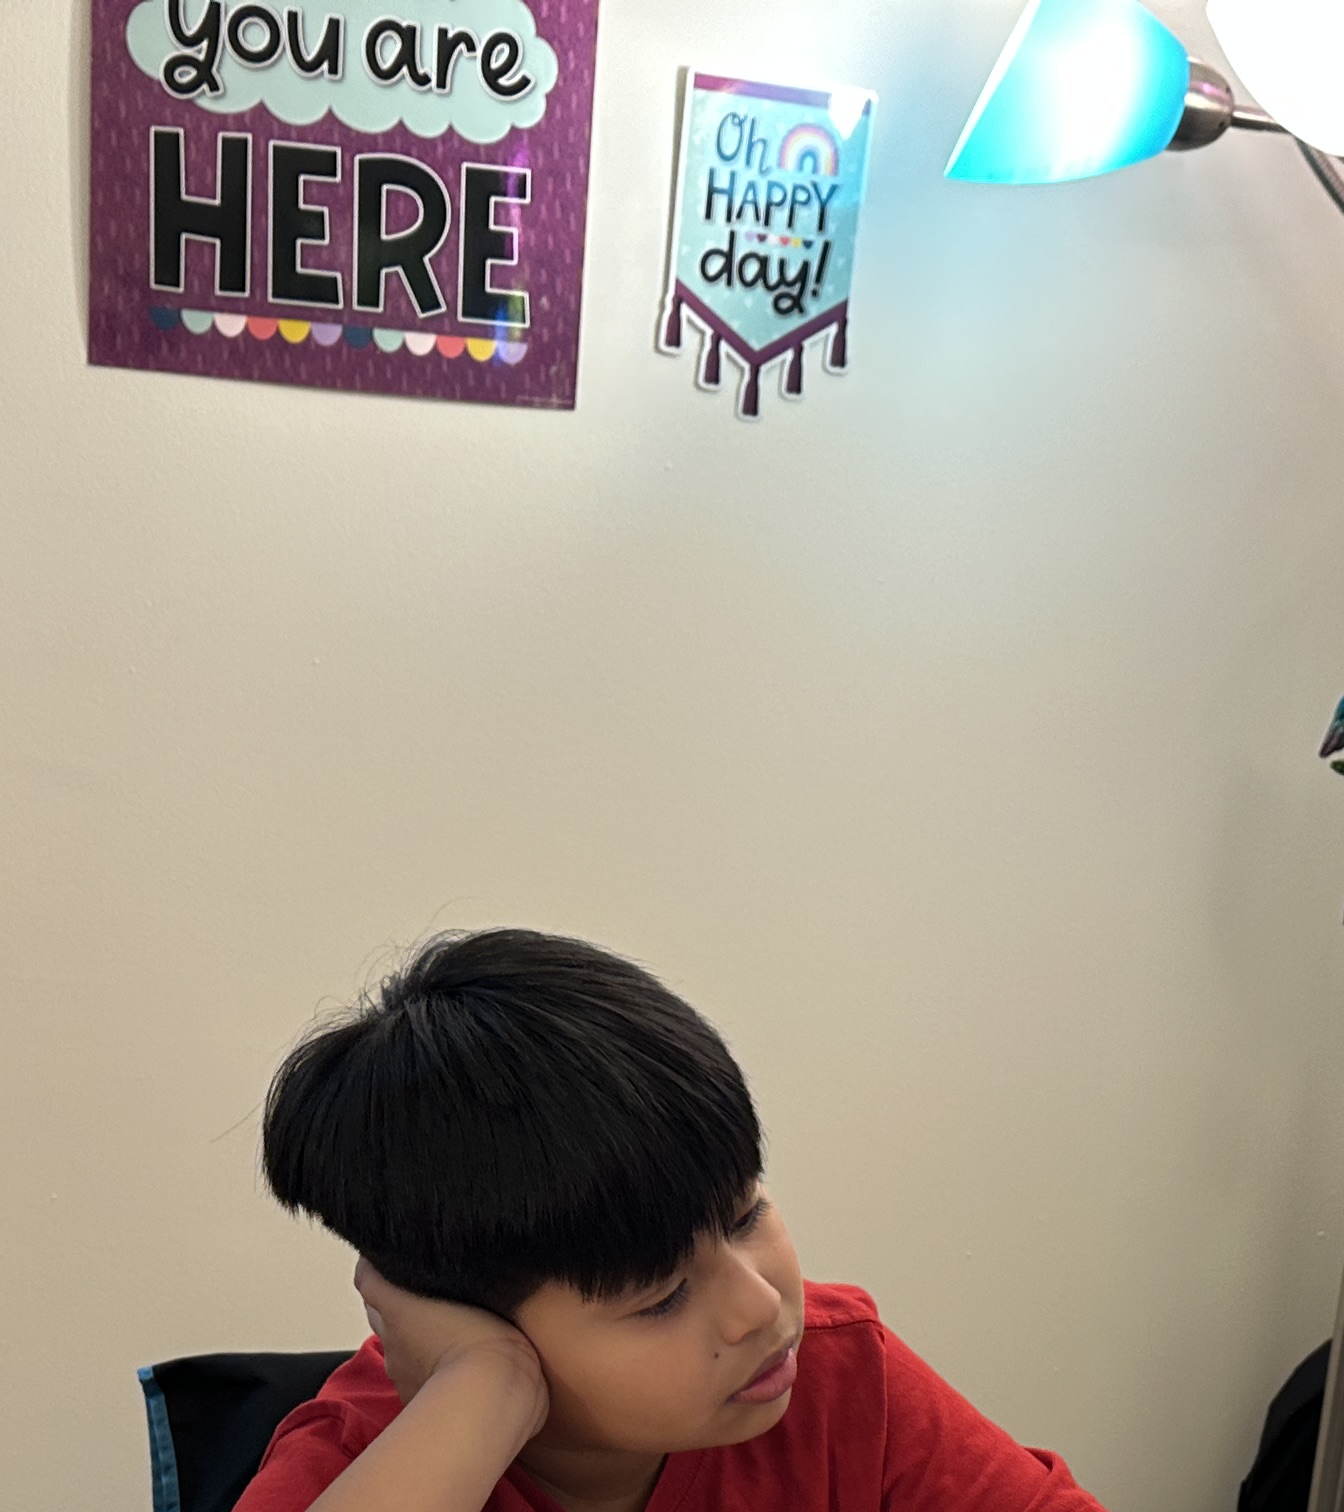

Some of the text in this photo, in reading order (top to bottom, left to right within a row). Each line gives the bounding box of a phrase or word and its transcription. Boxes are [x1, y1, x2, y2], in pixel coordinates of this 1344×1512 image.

[162, 0, 532, 98] you are
[716, 112, 771, 177] Oh
[150, 126, 531, 328] HERE
[704, 167, 840, 232] HAPPY
[700, 230, 832, 315] day!
